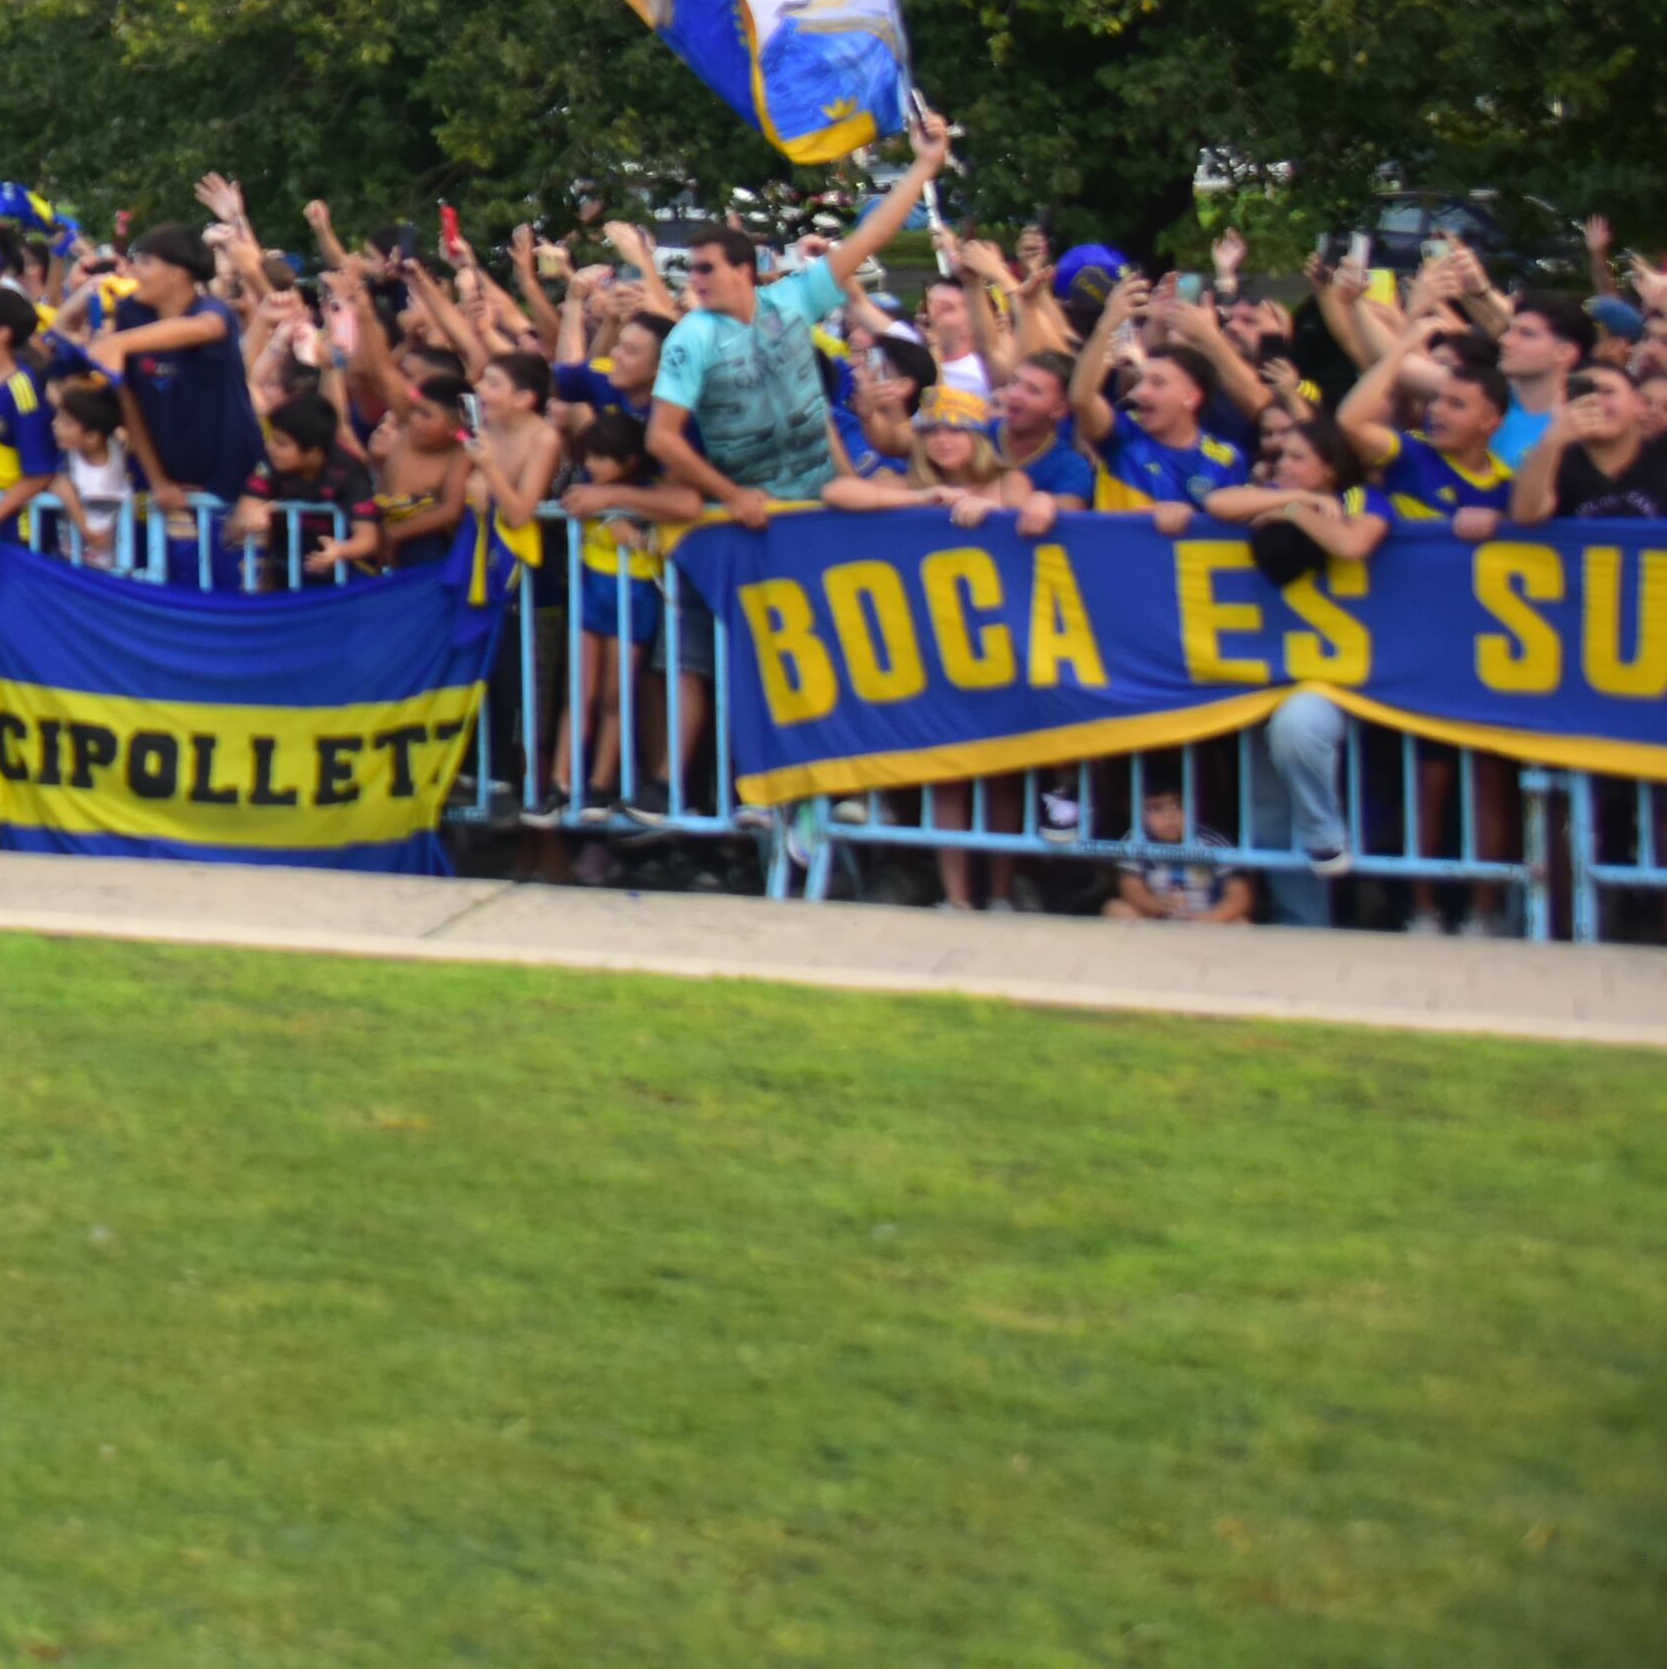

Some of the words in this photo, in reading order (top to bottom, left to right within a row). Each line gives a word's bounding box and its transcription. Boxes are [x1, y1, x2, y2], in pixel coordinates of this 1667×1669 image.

[739, 543, 1109, 726] BOCA
[1174, 539, 1372, 686] ES
[1473, 542, 1667, 697] SU
